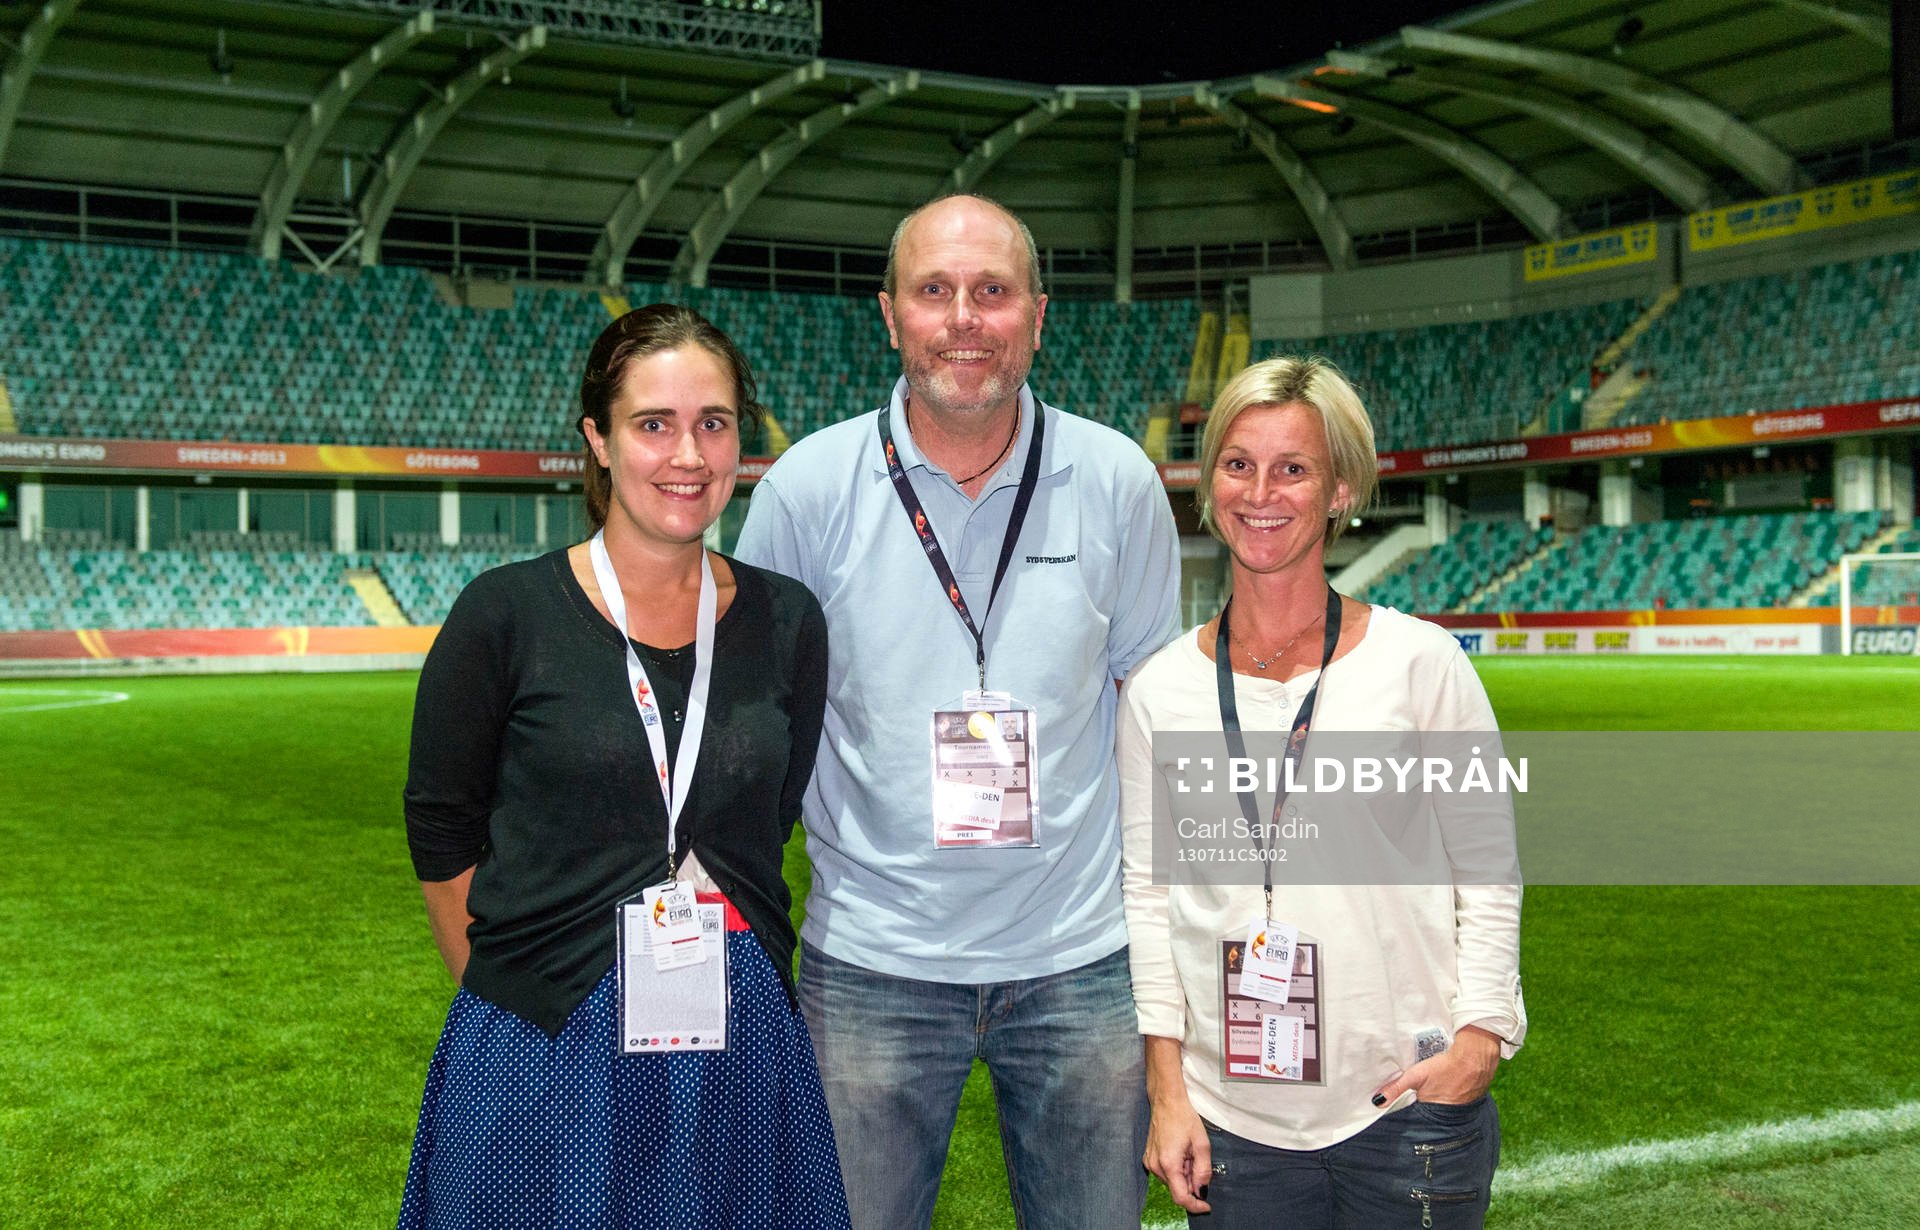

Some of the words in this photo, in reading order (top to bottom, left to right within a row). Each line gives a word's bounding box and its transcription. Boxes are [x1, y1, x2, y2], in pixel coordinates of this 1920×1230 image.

[59, 444, 106, 460] EURO
[406, 453, 479, 470] GÖTEBORG
[539, 457, 576, 472] UEFA
[1025, 554, 1076, 564] SYDSVENSKAN
[669, 908, 692, 921] EURO
[702, 921, 719, 930] EURO
[1266, 947, 1289, 961] EURO
[1267, 1018, 1277, 1060] SWE-DEN
